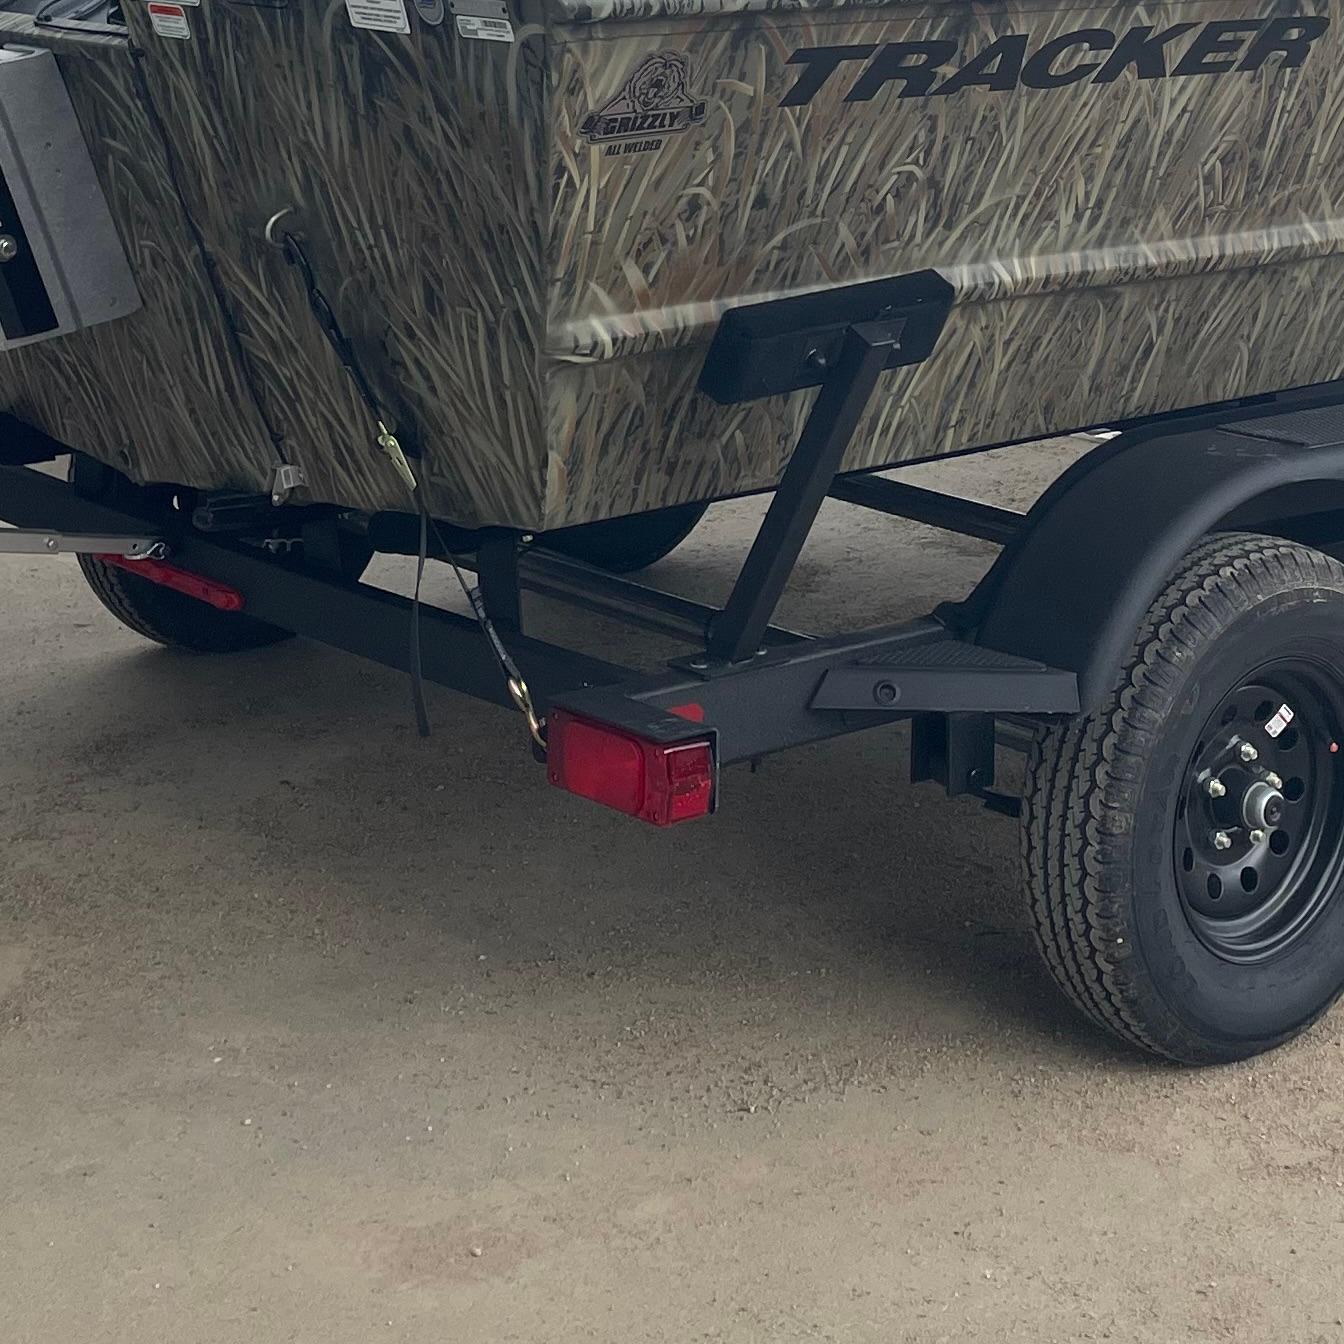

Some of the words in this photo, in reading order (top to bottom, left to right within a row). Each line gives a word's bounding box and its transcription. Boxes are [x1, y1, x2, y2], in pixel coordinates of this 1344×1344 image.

[778, 15, 1330, 108] TRACKER
[602, 111, 679, 136] GRIZZLY
[605, 144, 622, 156] ALL
[623, 139, 663, 155] WELDED
